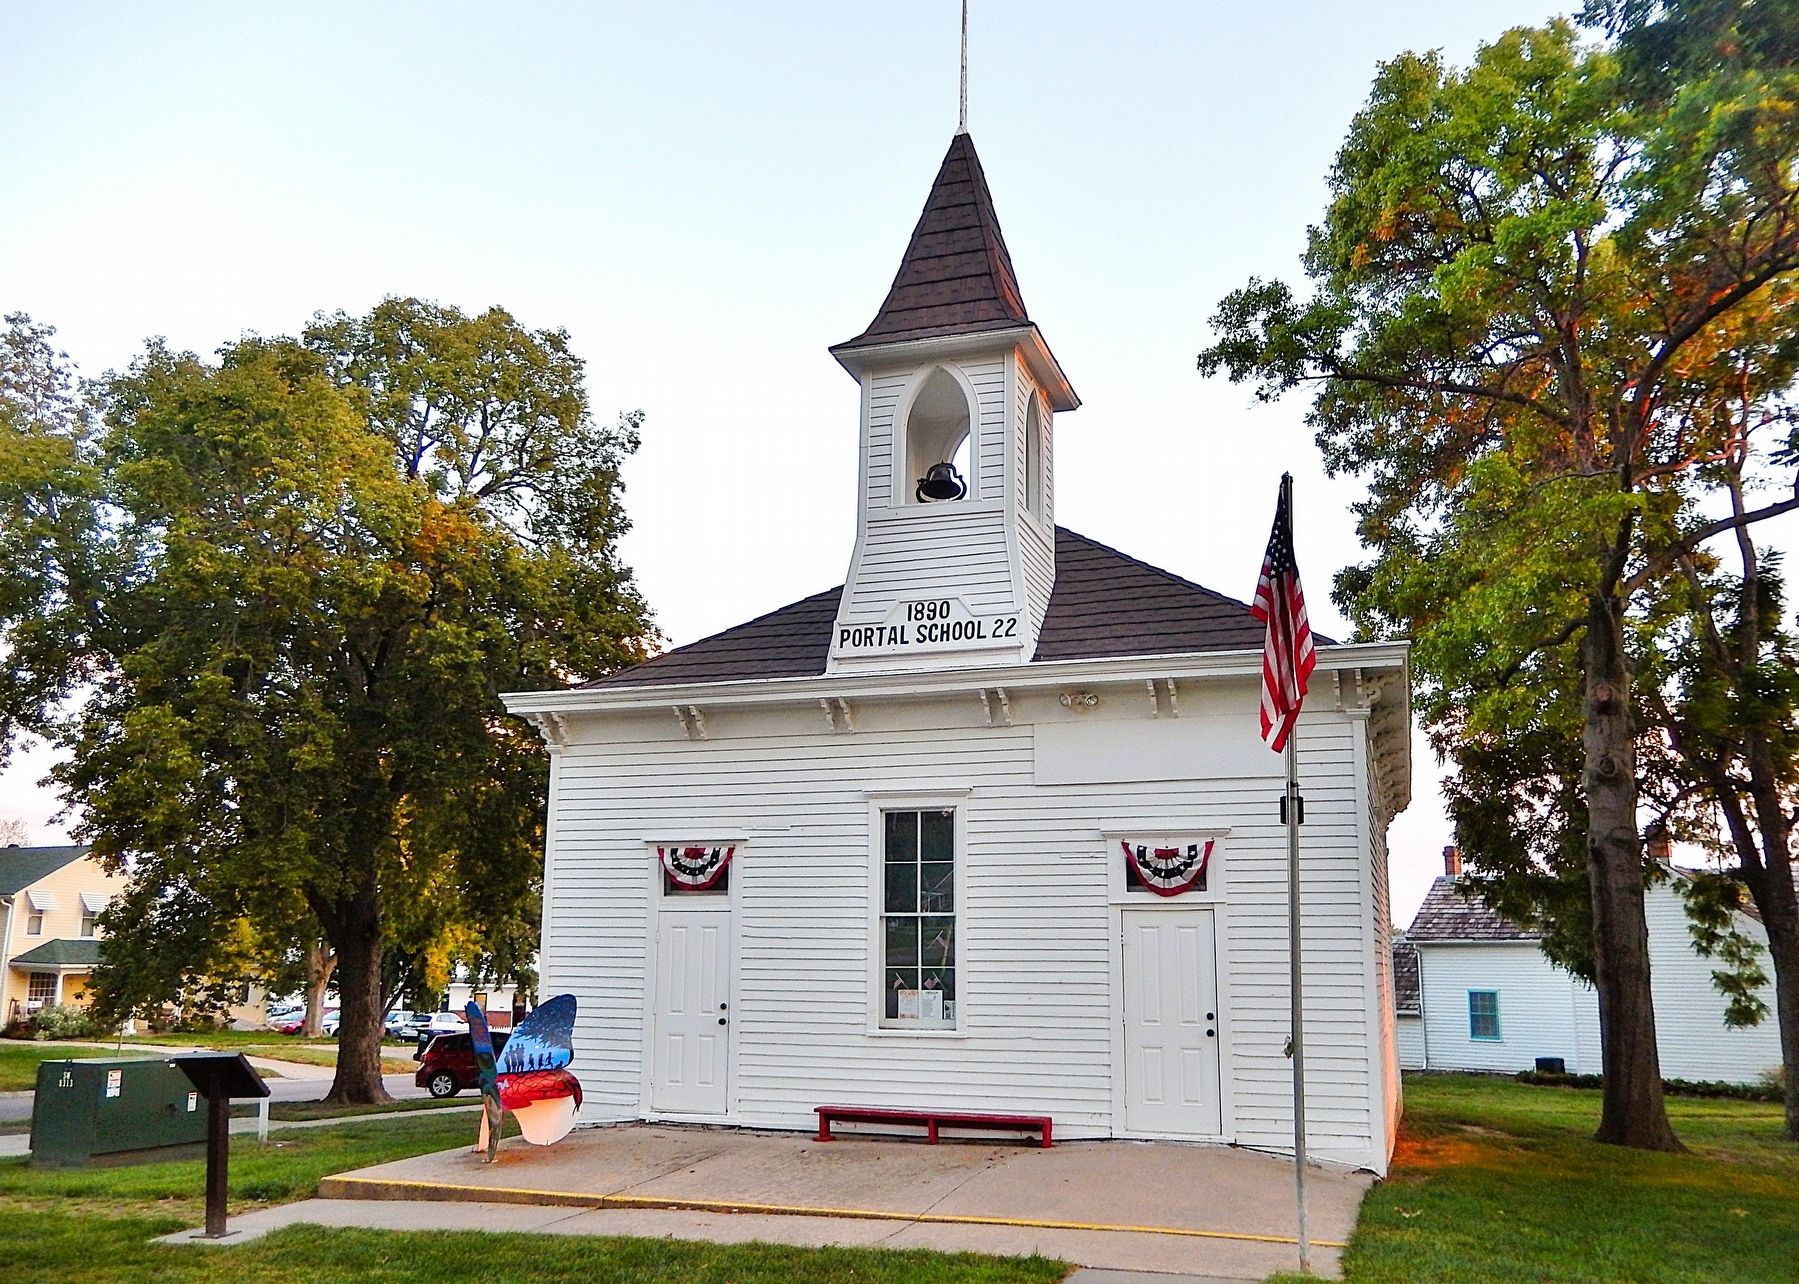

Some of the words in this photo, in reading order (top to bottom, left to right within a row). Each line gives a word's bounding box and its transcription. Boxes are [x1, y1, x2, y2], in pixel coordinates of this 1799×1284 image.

[907, 601, 950, 622] 1890
[839, 625, 909, 648] PORTAL
[916, 620, 987, 644] SCHOOL
[991, 617, 1017, 638] 22
